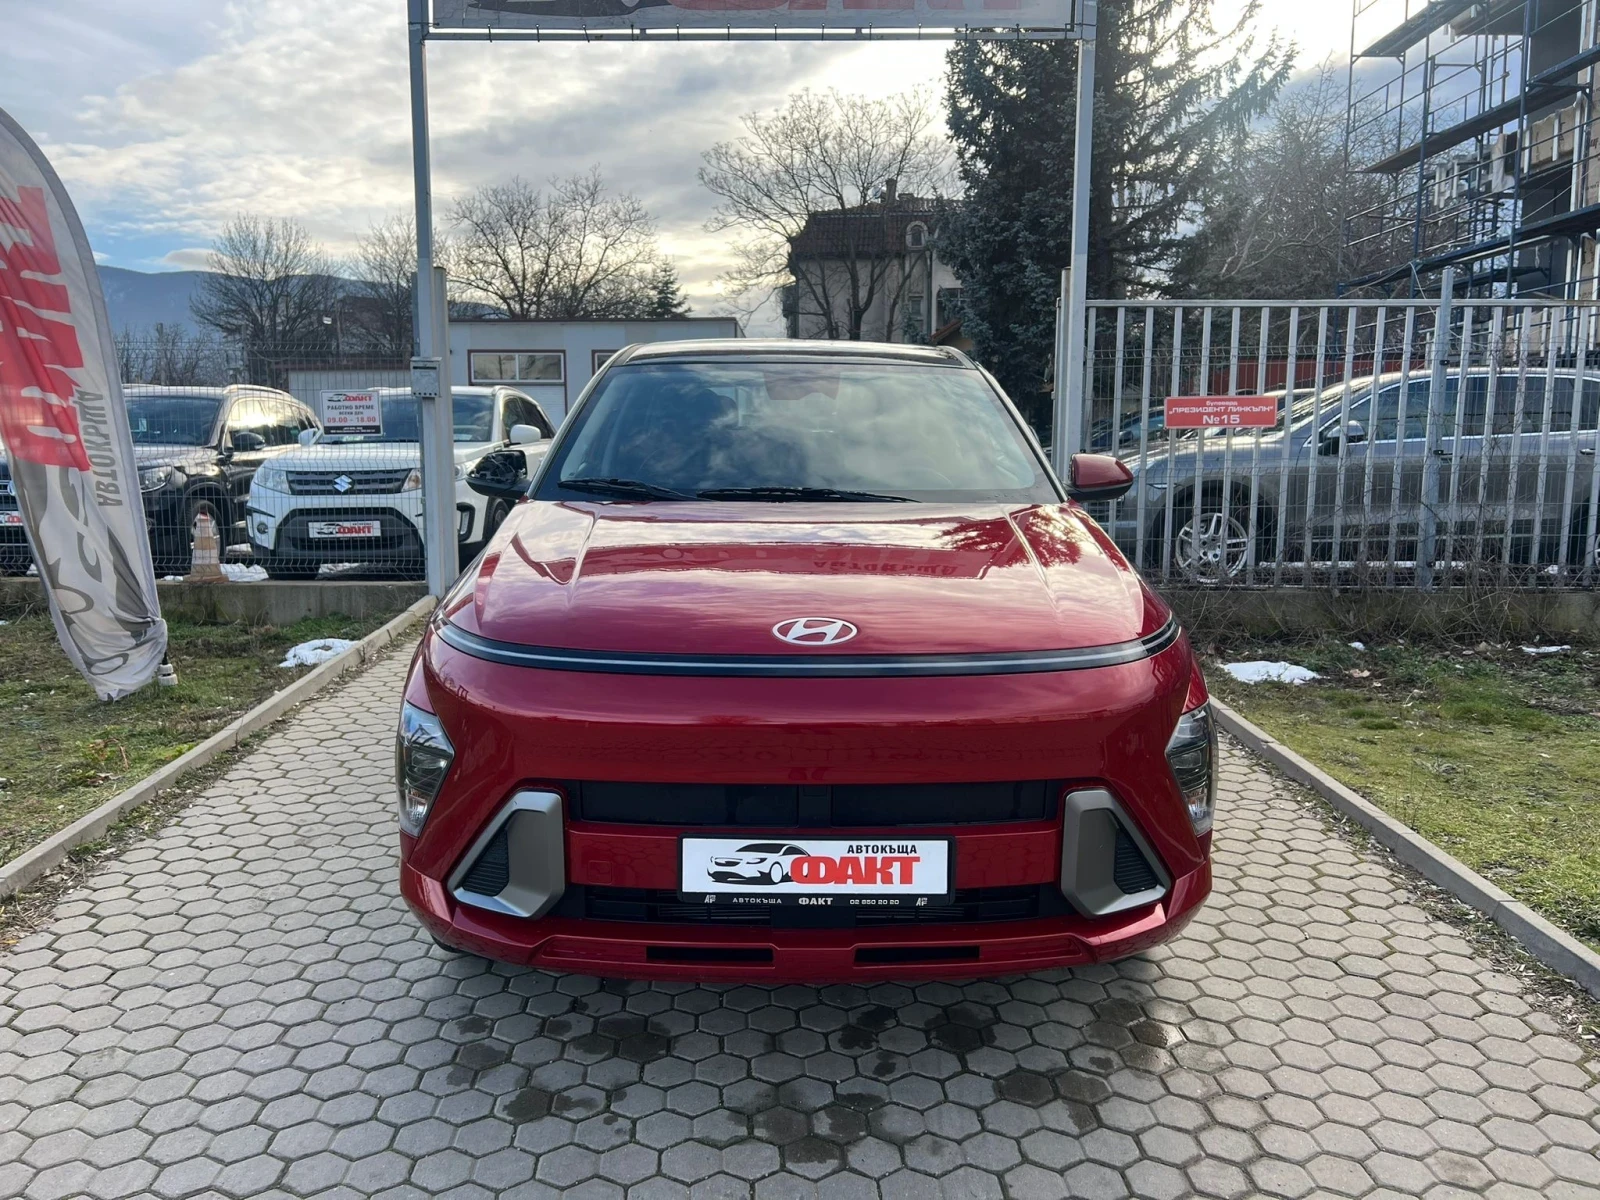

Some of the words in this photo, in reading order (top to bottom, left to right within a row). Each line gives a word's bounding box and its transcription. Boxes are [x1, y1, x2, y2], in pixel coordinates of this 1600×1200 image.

[847, 844, 917, 855] АВТОКЪЩА
[789, 855, 921, 886] ФАКТ
[798, 897, 834, 906] ФАКТ
